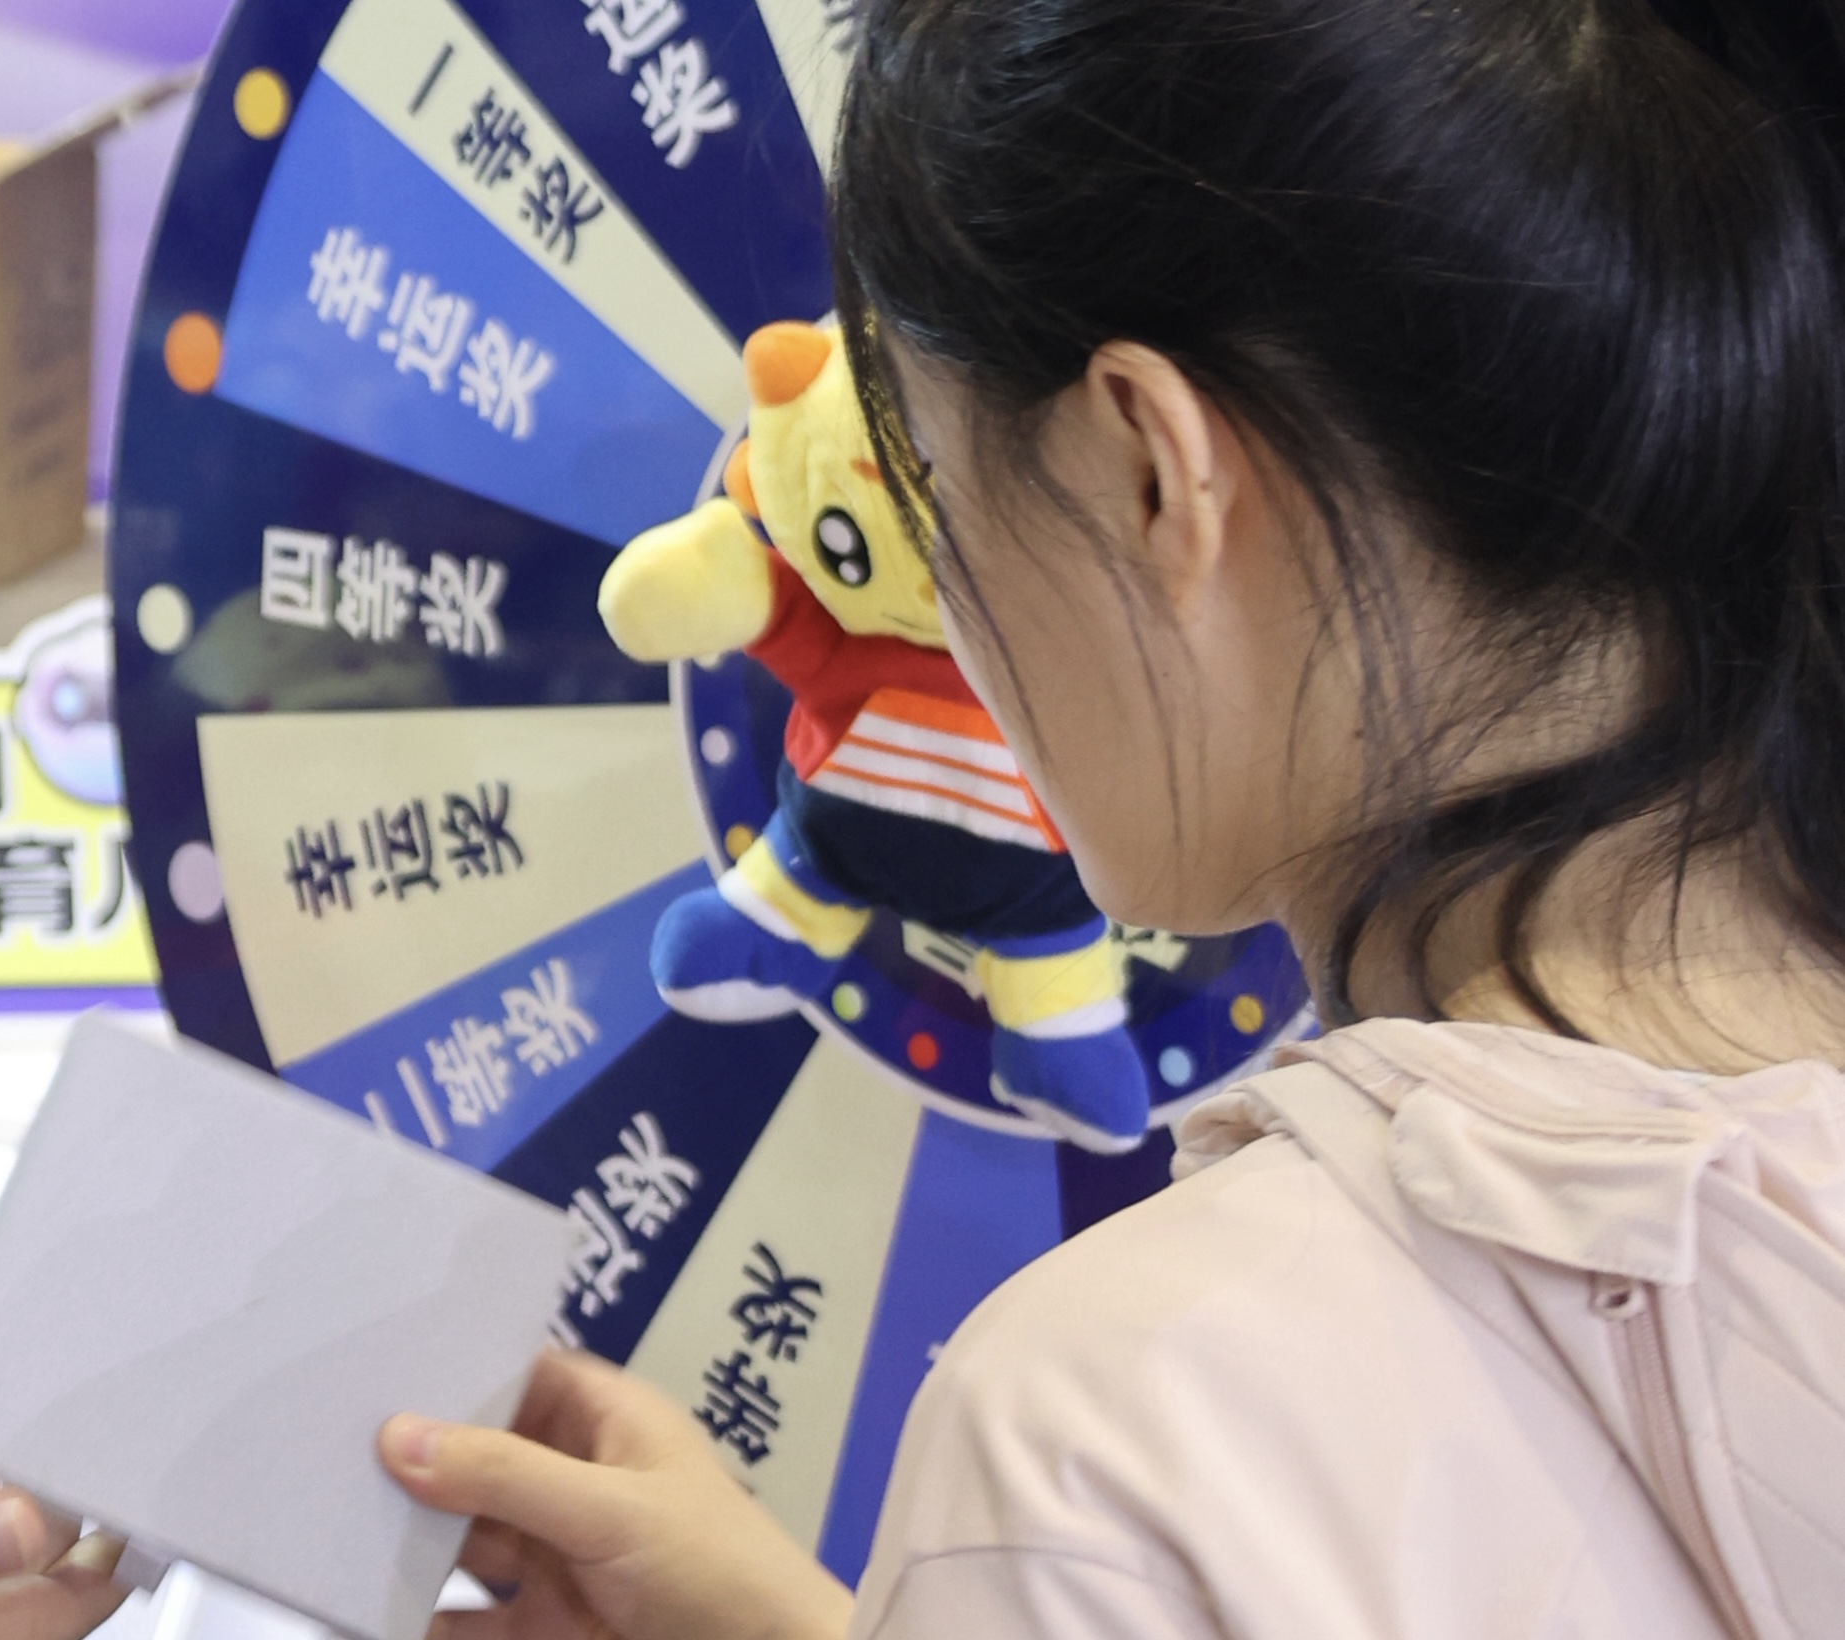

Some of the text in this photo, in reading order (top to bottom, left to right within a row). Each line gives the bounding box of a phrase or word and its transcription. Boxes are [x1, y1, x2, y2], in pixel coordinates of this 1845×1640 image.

[407, 41, 606, 264] 一等奖
[306, 226, 555, 441] 幸运奖
[260, 526, 507, 659] 四等奖
[284, 778, 525, 922] 幸运奖
[547, 1110, 702, 1352] 运奖
[692, 1240, 825, 1470] 等奖
